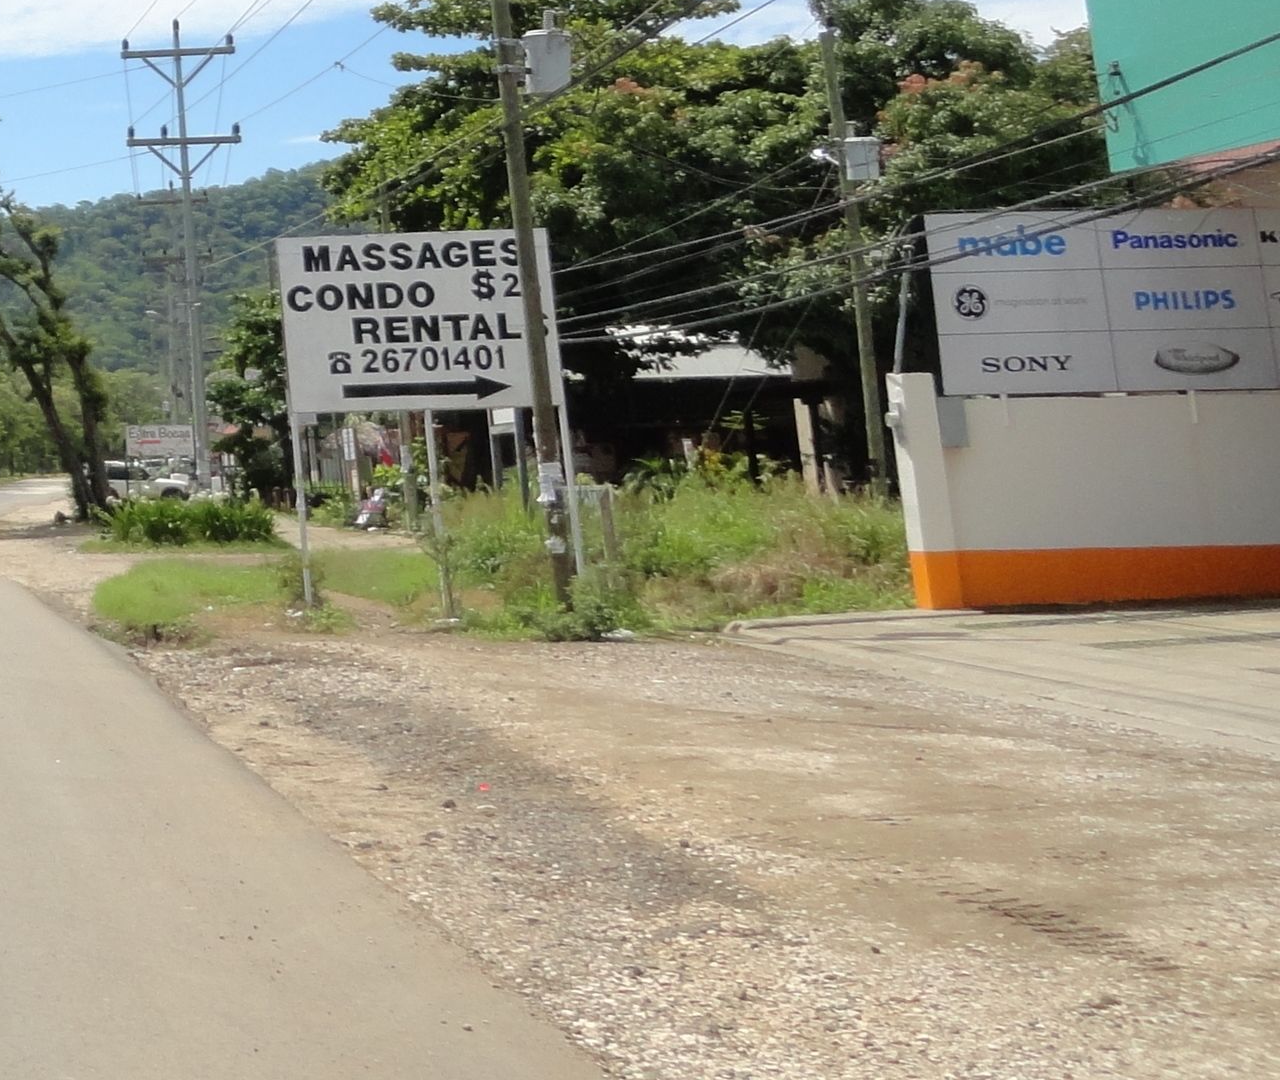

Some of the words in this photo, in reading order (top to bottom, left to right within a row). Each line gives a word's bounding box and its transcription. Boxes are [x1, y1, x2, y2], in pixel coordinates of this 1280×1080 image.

[958, 224, 1067, 257] mabe
[1112, 229, 1238, 250] Panasonic
[302, 238, 518, 272] MASSAGES
[287, 281, 435, 312] CONDO
[1134, 289, 1236, 311] PHILIPS
[351, 313, 548, 344] RENTAL
[361, 344, 505, 373] 26701401
[981, 355, 1072, 373] SONY
